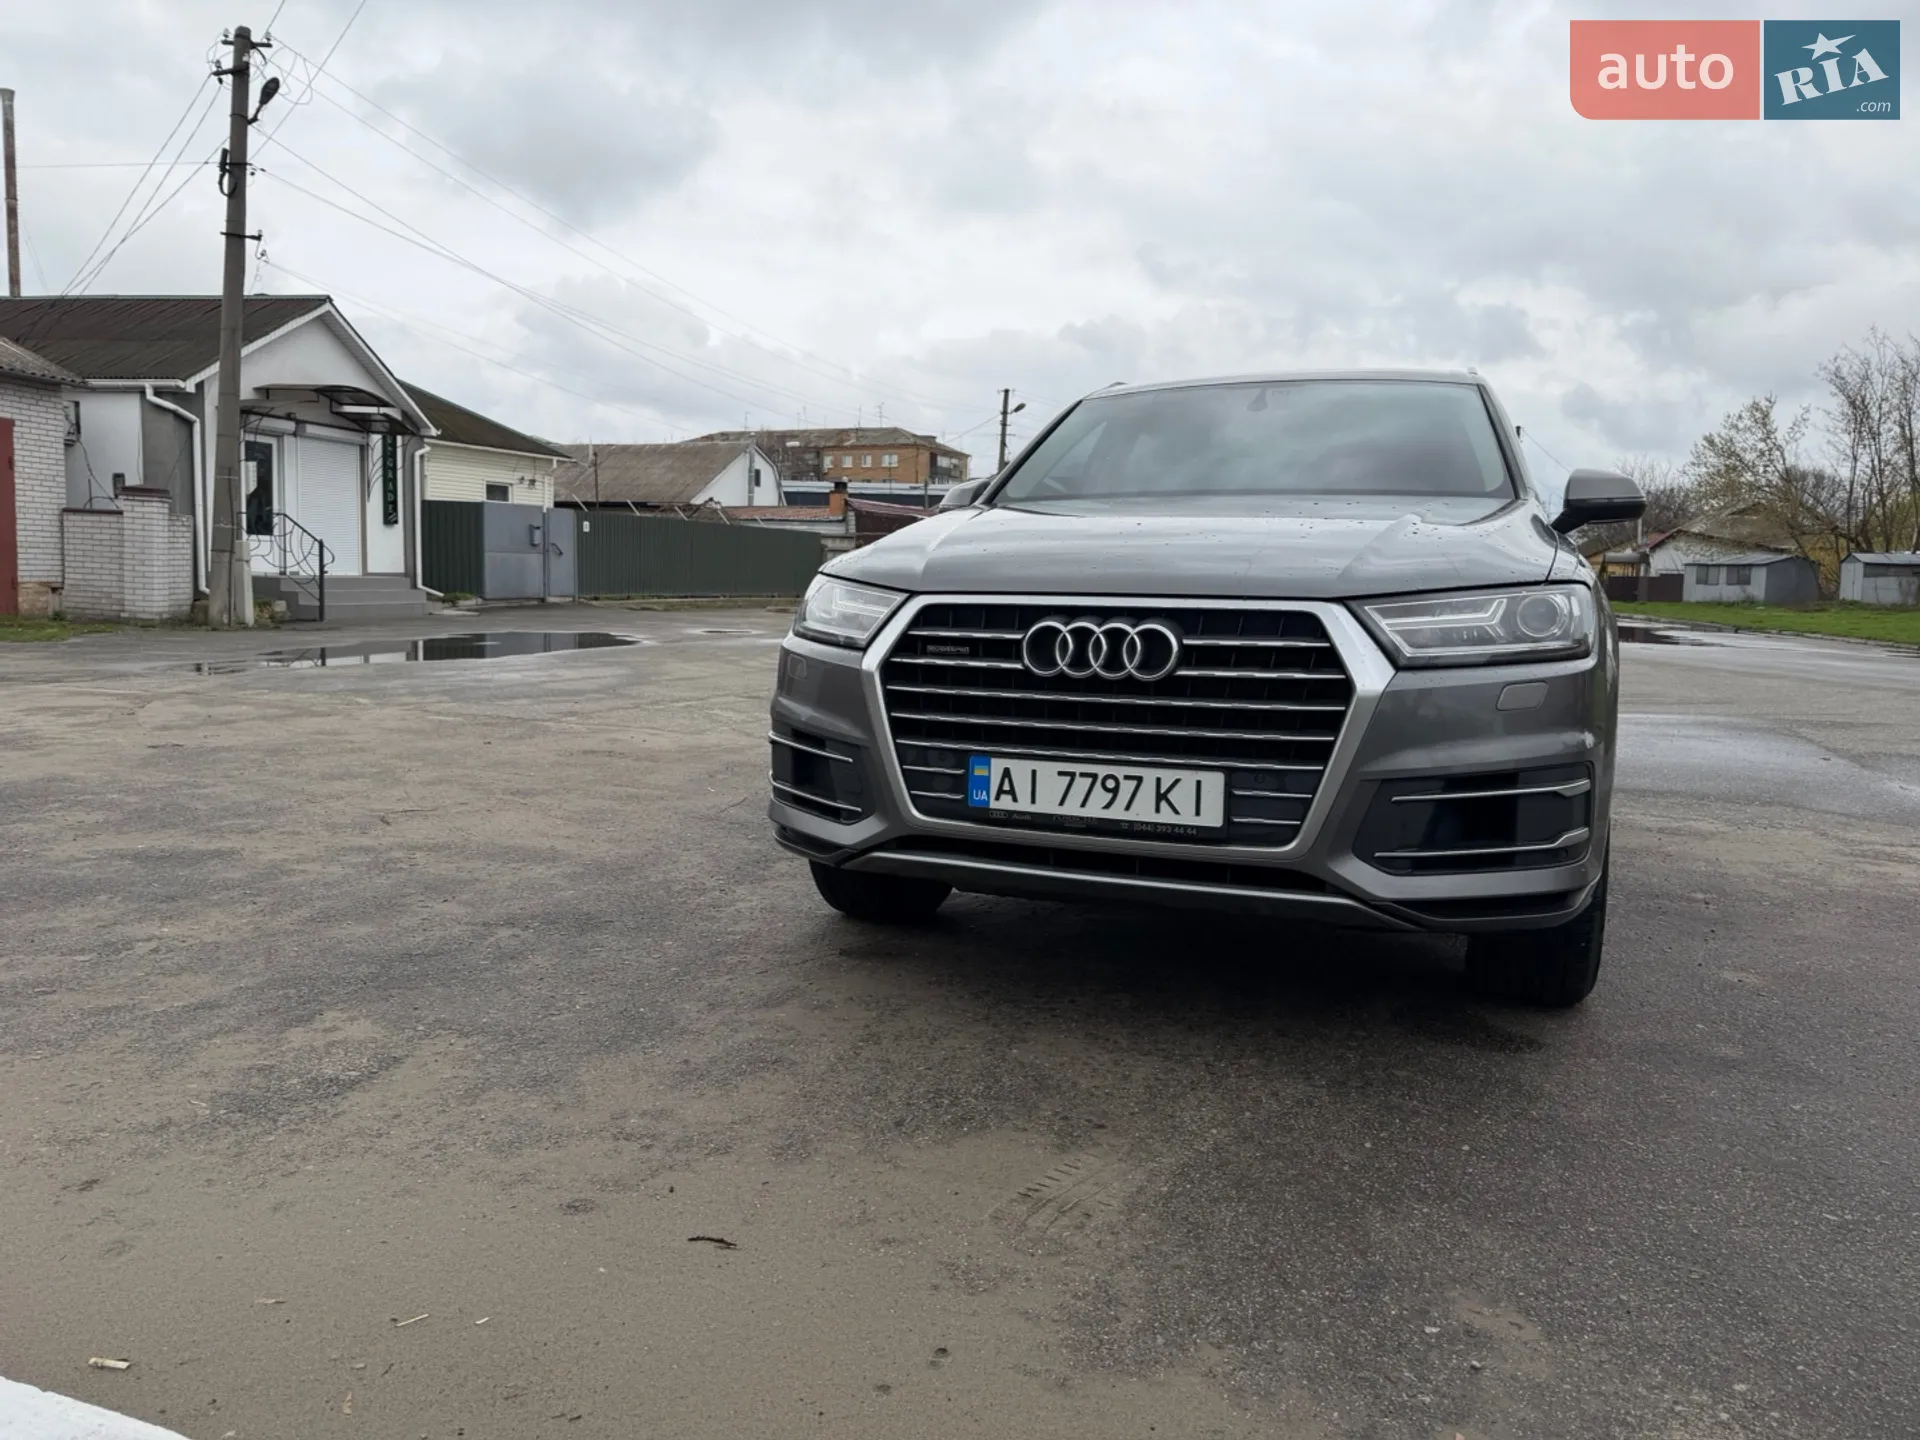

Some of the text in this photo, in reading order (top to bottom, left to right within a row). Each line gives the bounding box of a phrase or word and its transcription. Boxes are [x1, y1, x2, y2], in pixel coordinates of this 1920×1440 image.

[973, 789, 988, 801] UA
[994, 766, 1203, 817] AI 7797 KI
